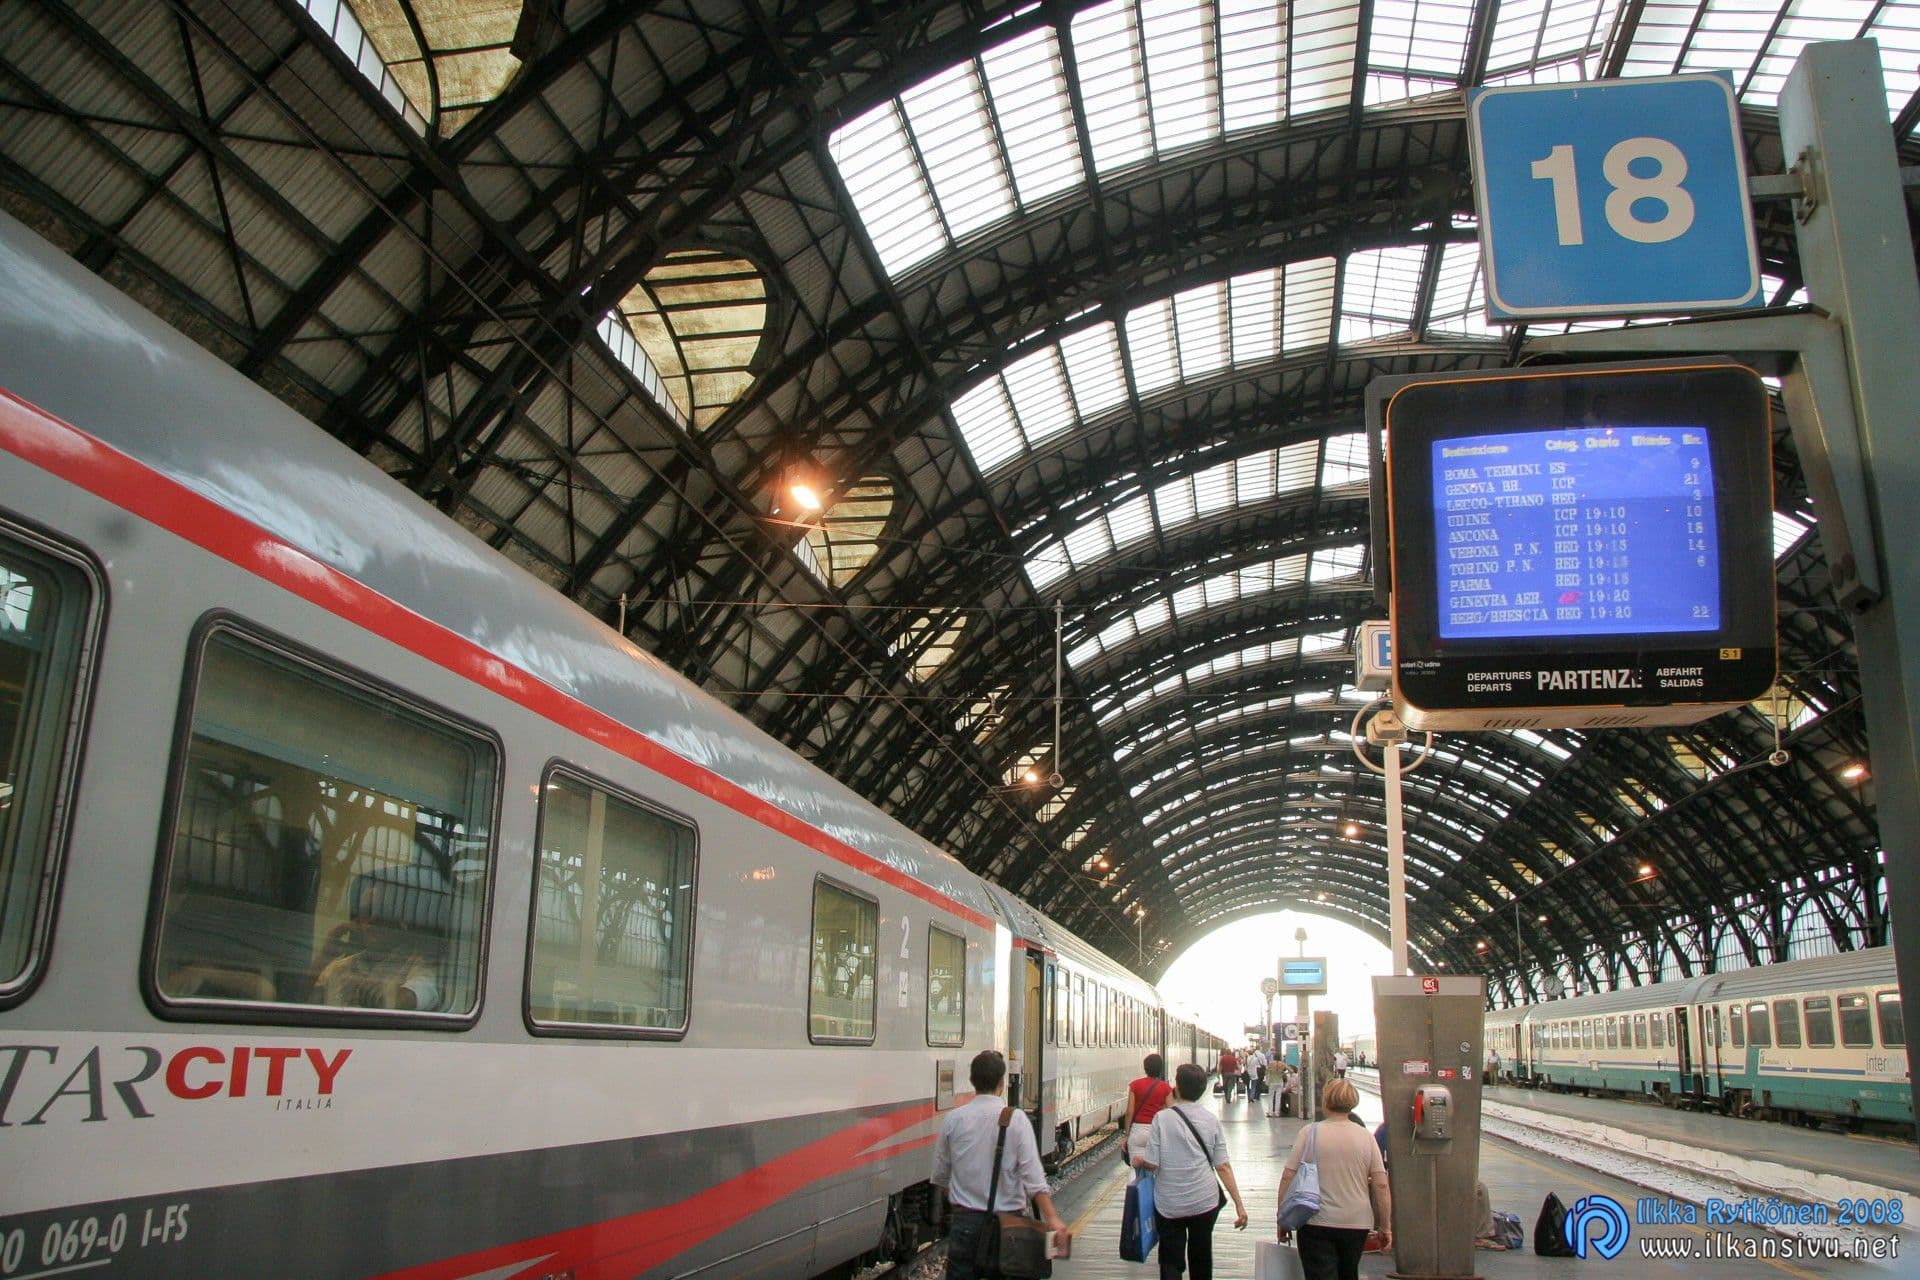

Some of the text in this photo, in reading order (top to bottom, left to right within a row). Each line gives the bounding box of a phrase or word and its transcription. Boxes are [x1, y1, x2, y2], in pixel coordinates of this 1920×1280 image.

[1531, 136, 1695, 246] 18
[1446, 482, 1496, 495] GENOVA
[1448, 495, 1544, 511] LECCO-TIRANO
[1555, 509, 1577, 520] ICP
[1586, 507, 1626, 519] 19:10
[1449, 529, 1499, 542] ANCONA
[1556, 525, 1578, 536] ICP
[1588, 523, 1627, 535] 19:10
[1450, 546, 1499, 558] VERONA
[1450, 562, 1499, 575] TORINO
[1451, 579, 1492, 592] PARMA
[1590, 590, 1630, 601] 19:20
[1591, 606, 1632, 618] 19:20
[1467, 671, 1532, 681] DEPARTURES
[1656, 667, 1703, 677] ABFAHRT
[1467, 679, 1704, 692] DEPARTS SALIDAS
[900, 915, 910, 959] 2
[165, 1046, 354, 1100] CITY
[275, 1098, 332, 1111] ITALIA
[0, 1203, 191, 1274] 0 069-0 I-FS
